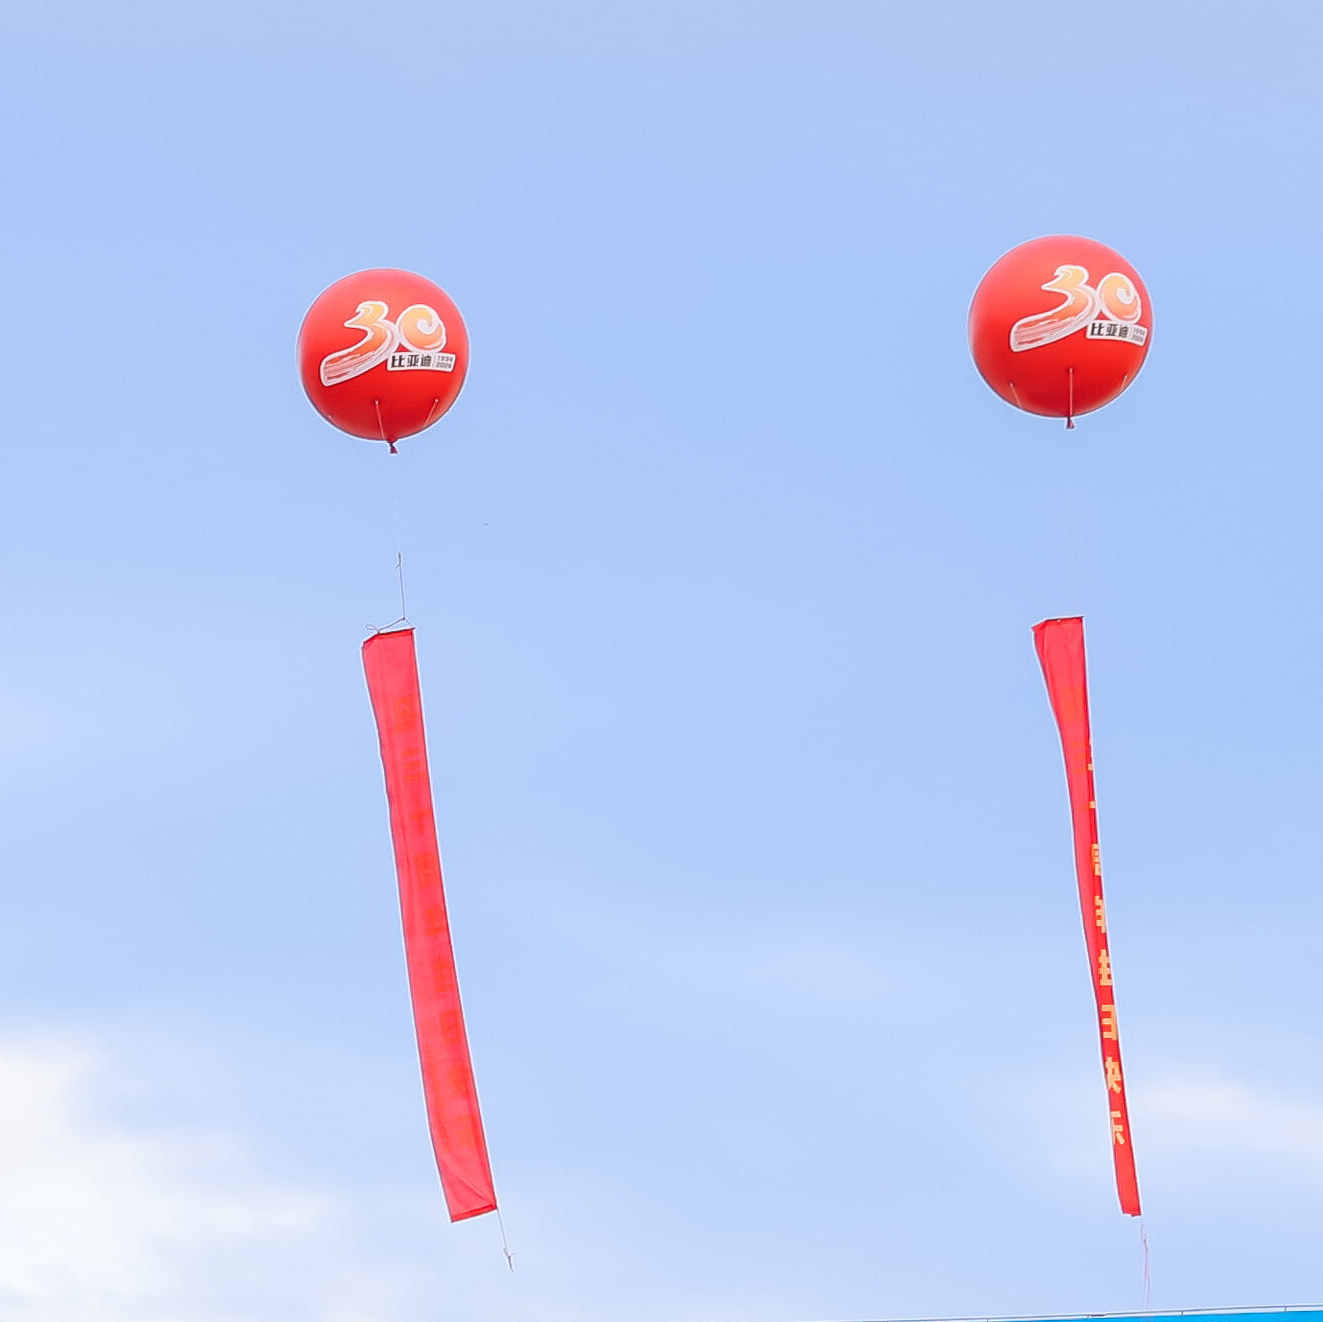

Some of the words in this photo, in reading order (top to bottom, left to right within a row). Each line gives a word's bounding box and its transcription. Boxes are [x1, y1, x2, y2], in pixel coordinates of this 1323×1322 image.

[1090, 322, 1129, 338] 比亚迪
[391, 354, 432, 368] 比亚迪
